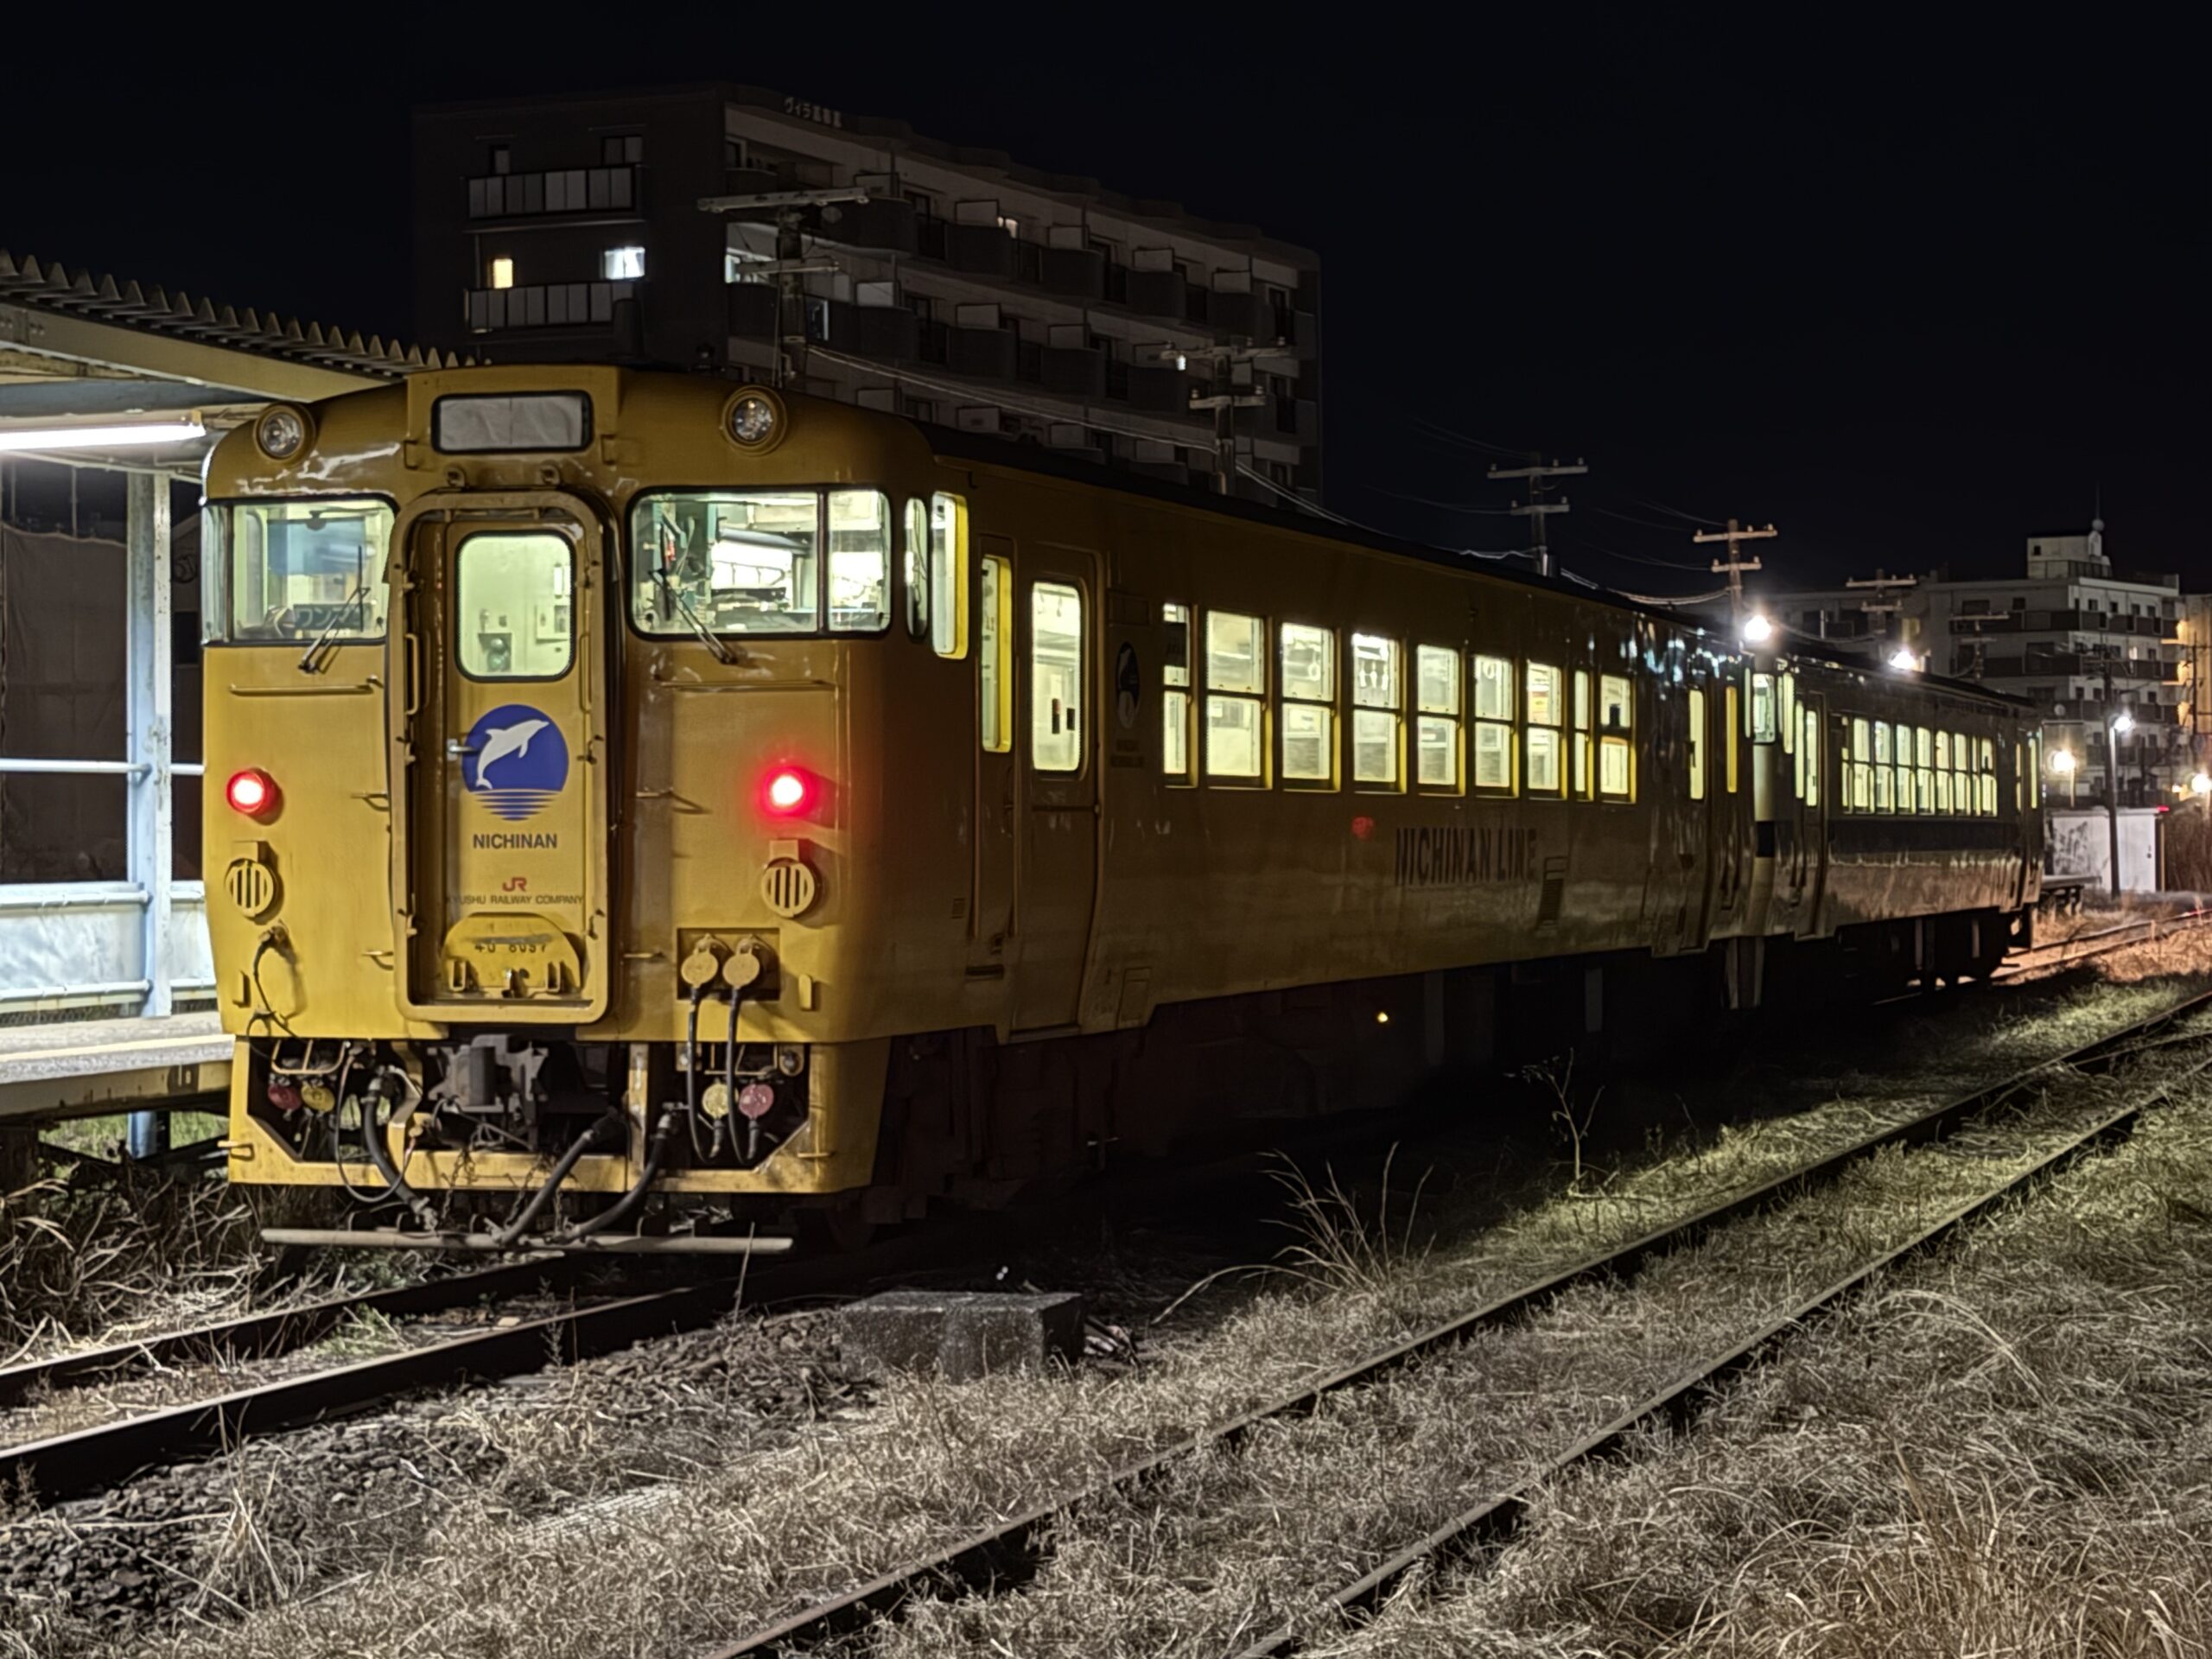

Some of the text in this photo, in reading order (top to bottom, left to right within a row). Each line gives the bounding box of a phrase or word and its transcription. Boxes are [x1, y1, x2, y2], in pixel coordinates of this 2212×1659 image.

[473, 833, 557, 849] NICHINAN
[1395, 827, 1491, 886] NICHINAN
[502, 877, 527, 892] JR
[490, 895, 532, 905] RAILWAY
[536, 895, 583, 905] COMPANY
